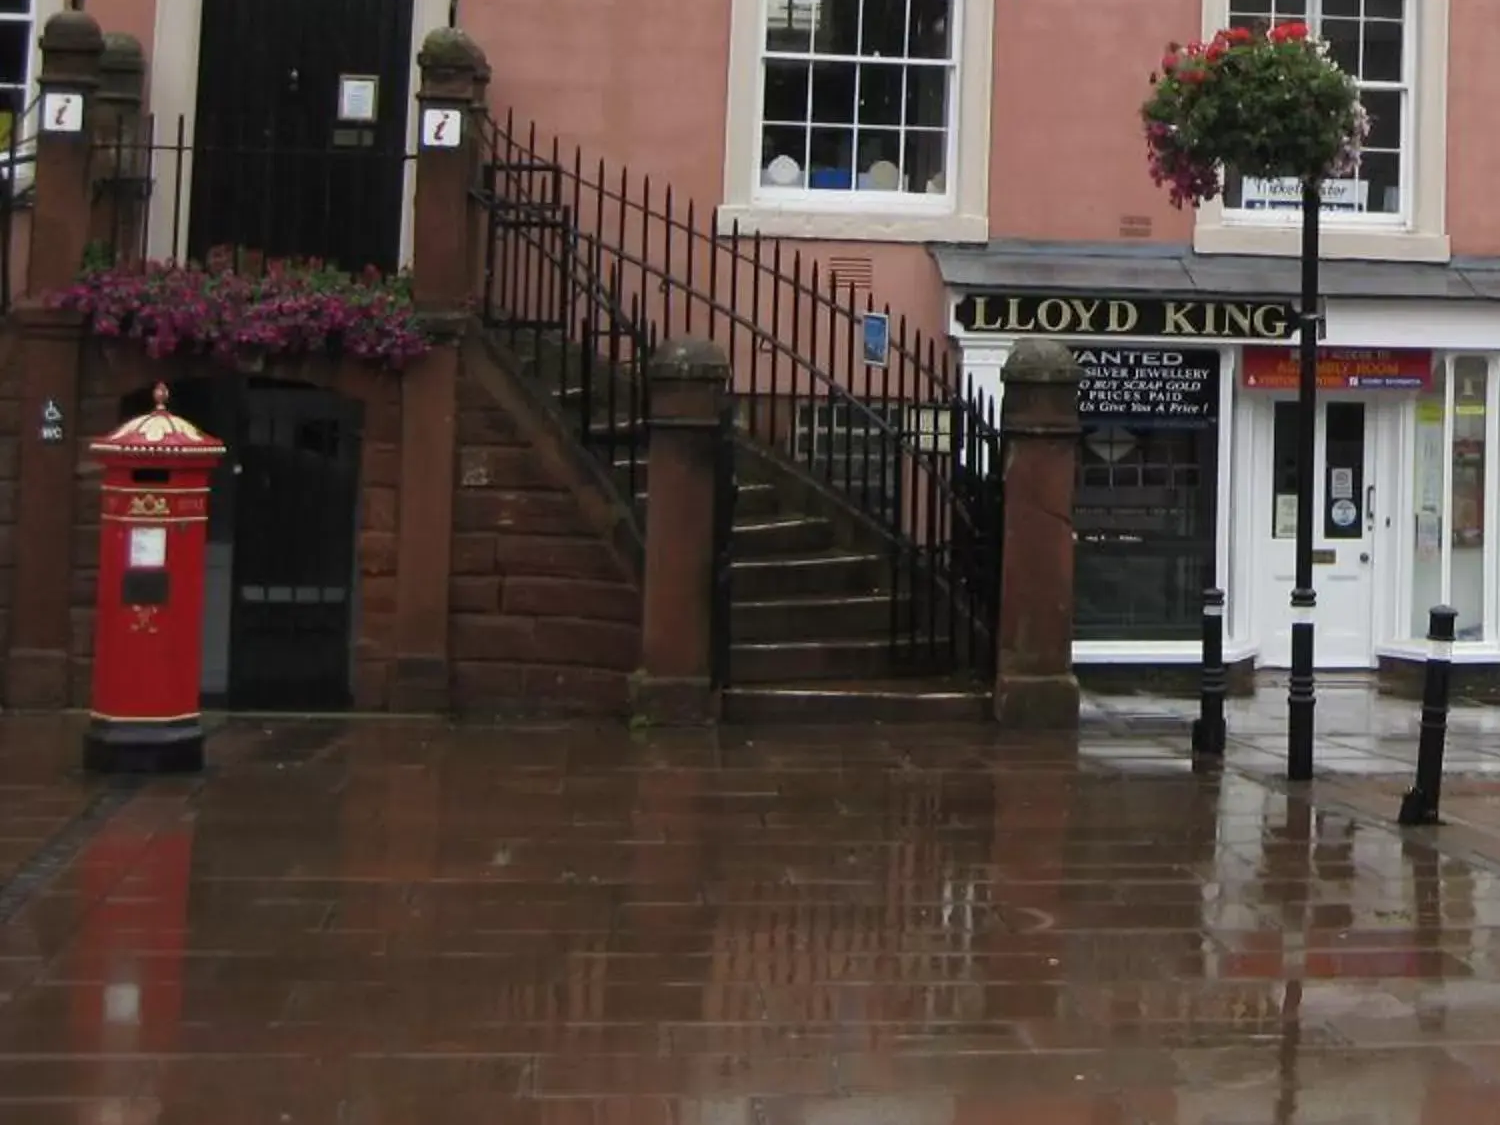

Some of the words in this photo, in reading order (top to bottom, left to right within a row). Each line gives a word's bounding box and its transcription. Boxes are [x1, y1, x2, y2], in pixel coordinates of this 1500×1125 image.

[971, 296, 1138, 333] LLOYD
[1162, 302, 1288, 337] KING
[1134, 368, 1210, 380] JEWELLERY
[1123, 380, 1164, 391] SCRAP
[1166, 381, 1201, 391] GOLD
[1089, 390, 1141, 401] PRICES
[1149, 391, 1183, 402] PAID
[1099, 402, 1125, 412] Give
[1131, 403, 1151, 412] You
[1155, 403, 1166, 412] A
[1169, 403, 1199, 414] Price
